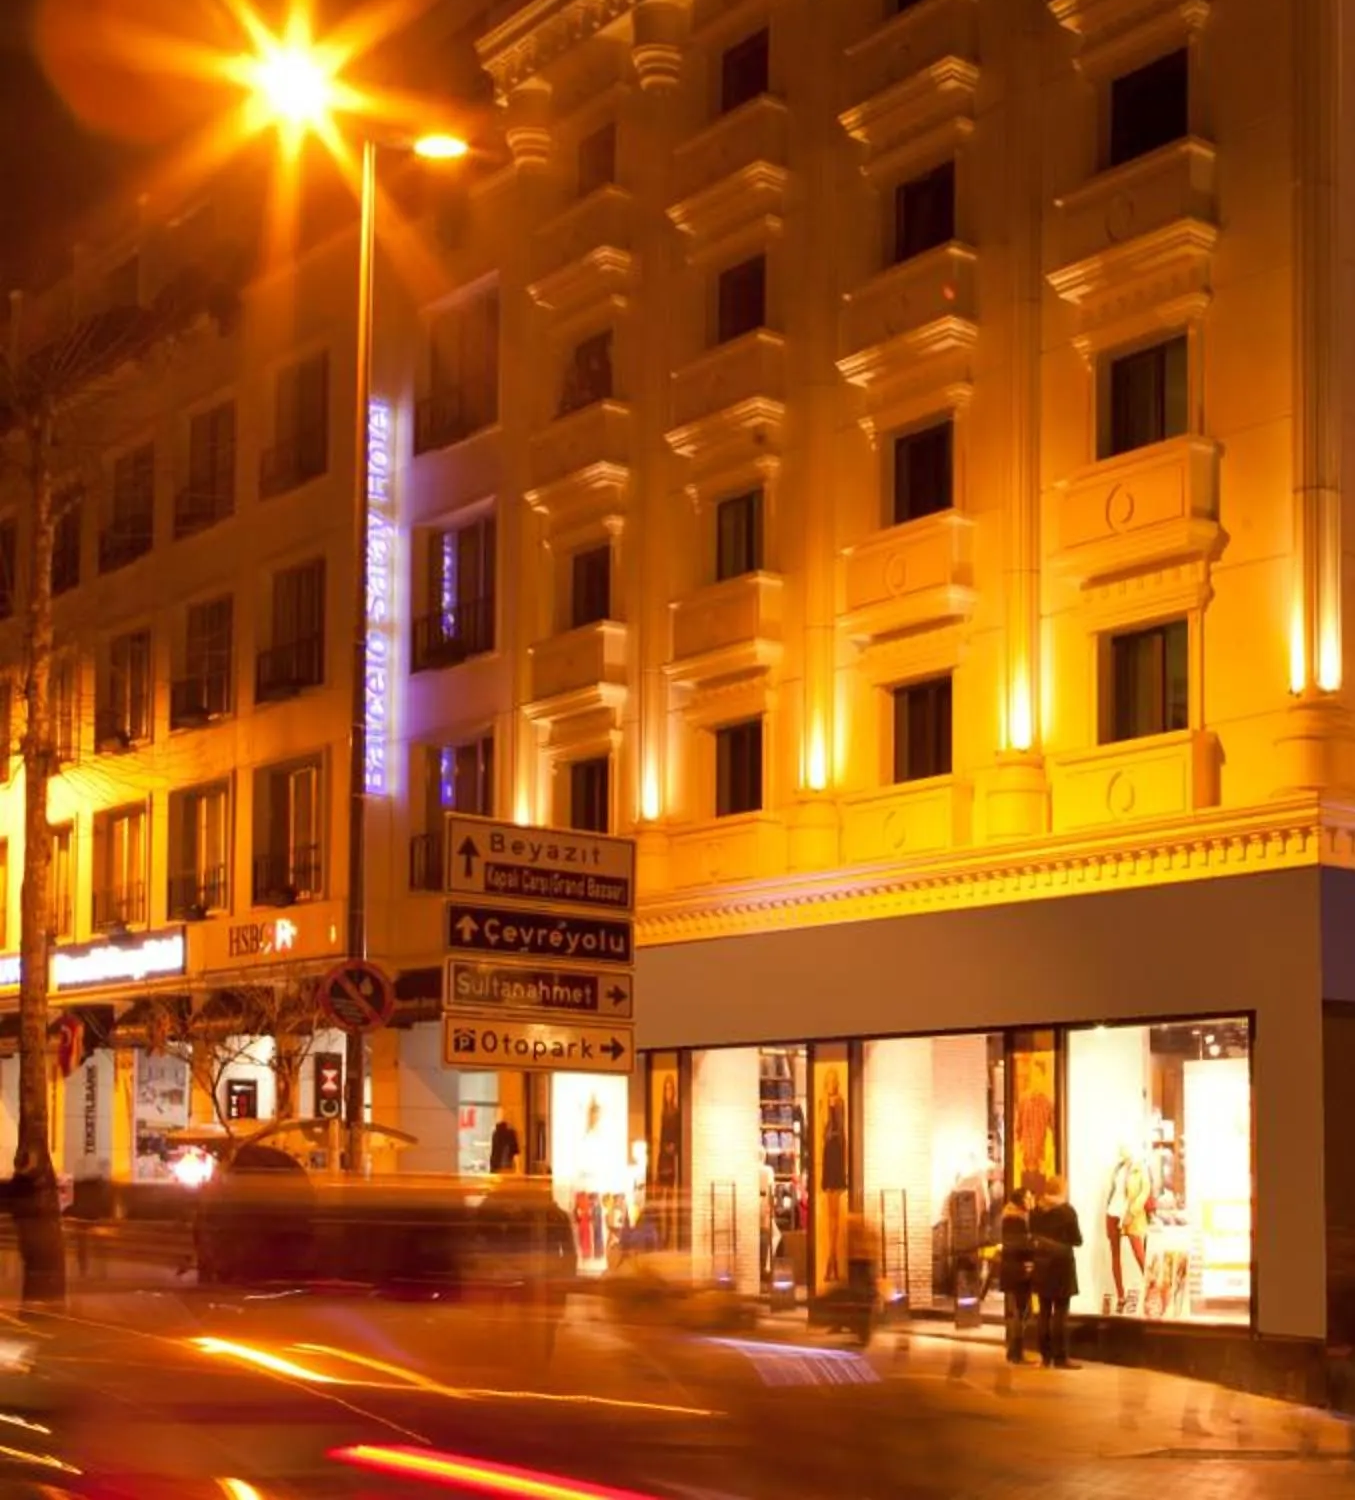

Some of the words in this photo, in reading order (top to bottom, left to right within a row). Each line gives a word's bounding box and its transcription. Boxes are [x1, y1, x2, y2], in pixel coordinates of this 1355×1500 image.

[483, 917, 625, 954] Çevreyolu
[456, 970, 594, 1005] Sultanahmet
[481, 1029, 594, 1061] Otopark
